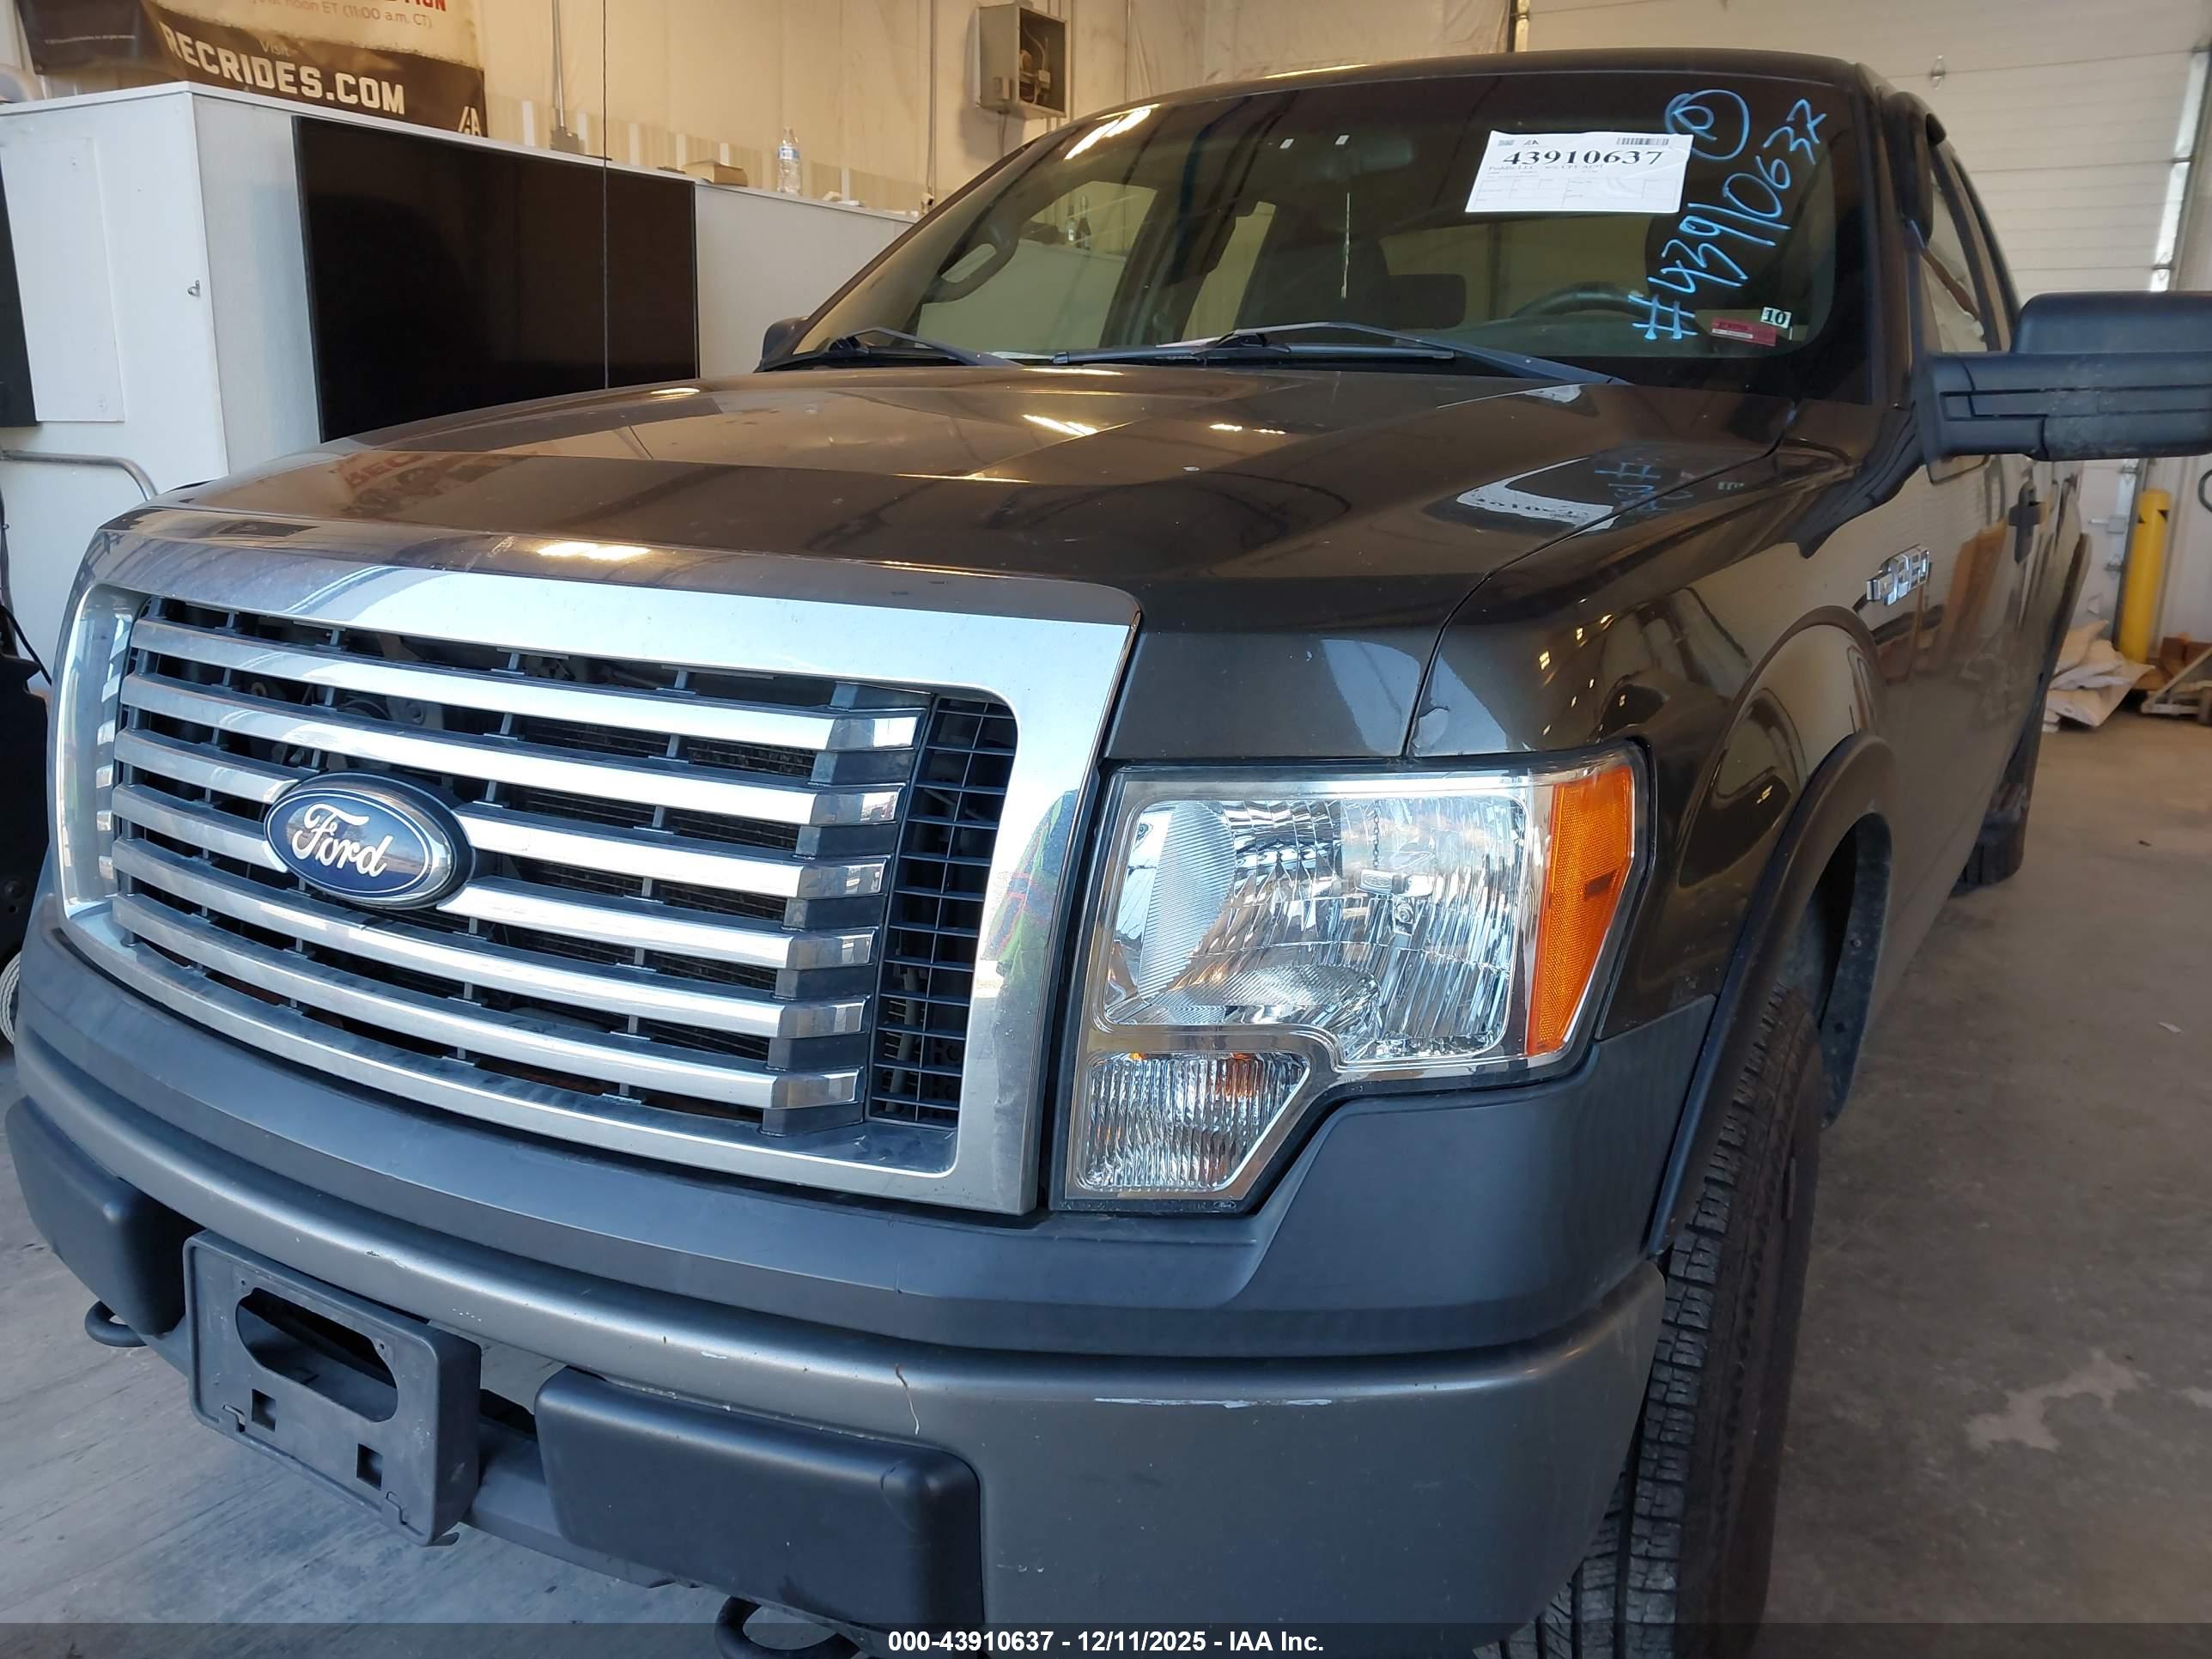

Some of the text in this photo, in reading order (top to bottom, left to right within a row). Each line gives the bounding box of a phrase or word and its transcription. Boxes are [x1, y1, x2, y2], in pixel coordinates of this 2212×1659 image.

[158, 20, 405, 115] RECRIDES.COM
[1503, 149, 1664, 166] 43910637
[1763, 308, 1787, 325] 10
[292, 803, 394, 878] Ford
